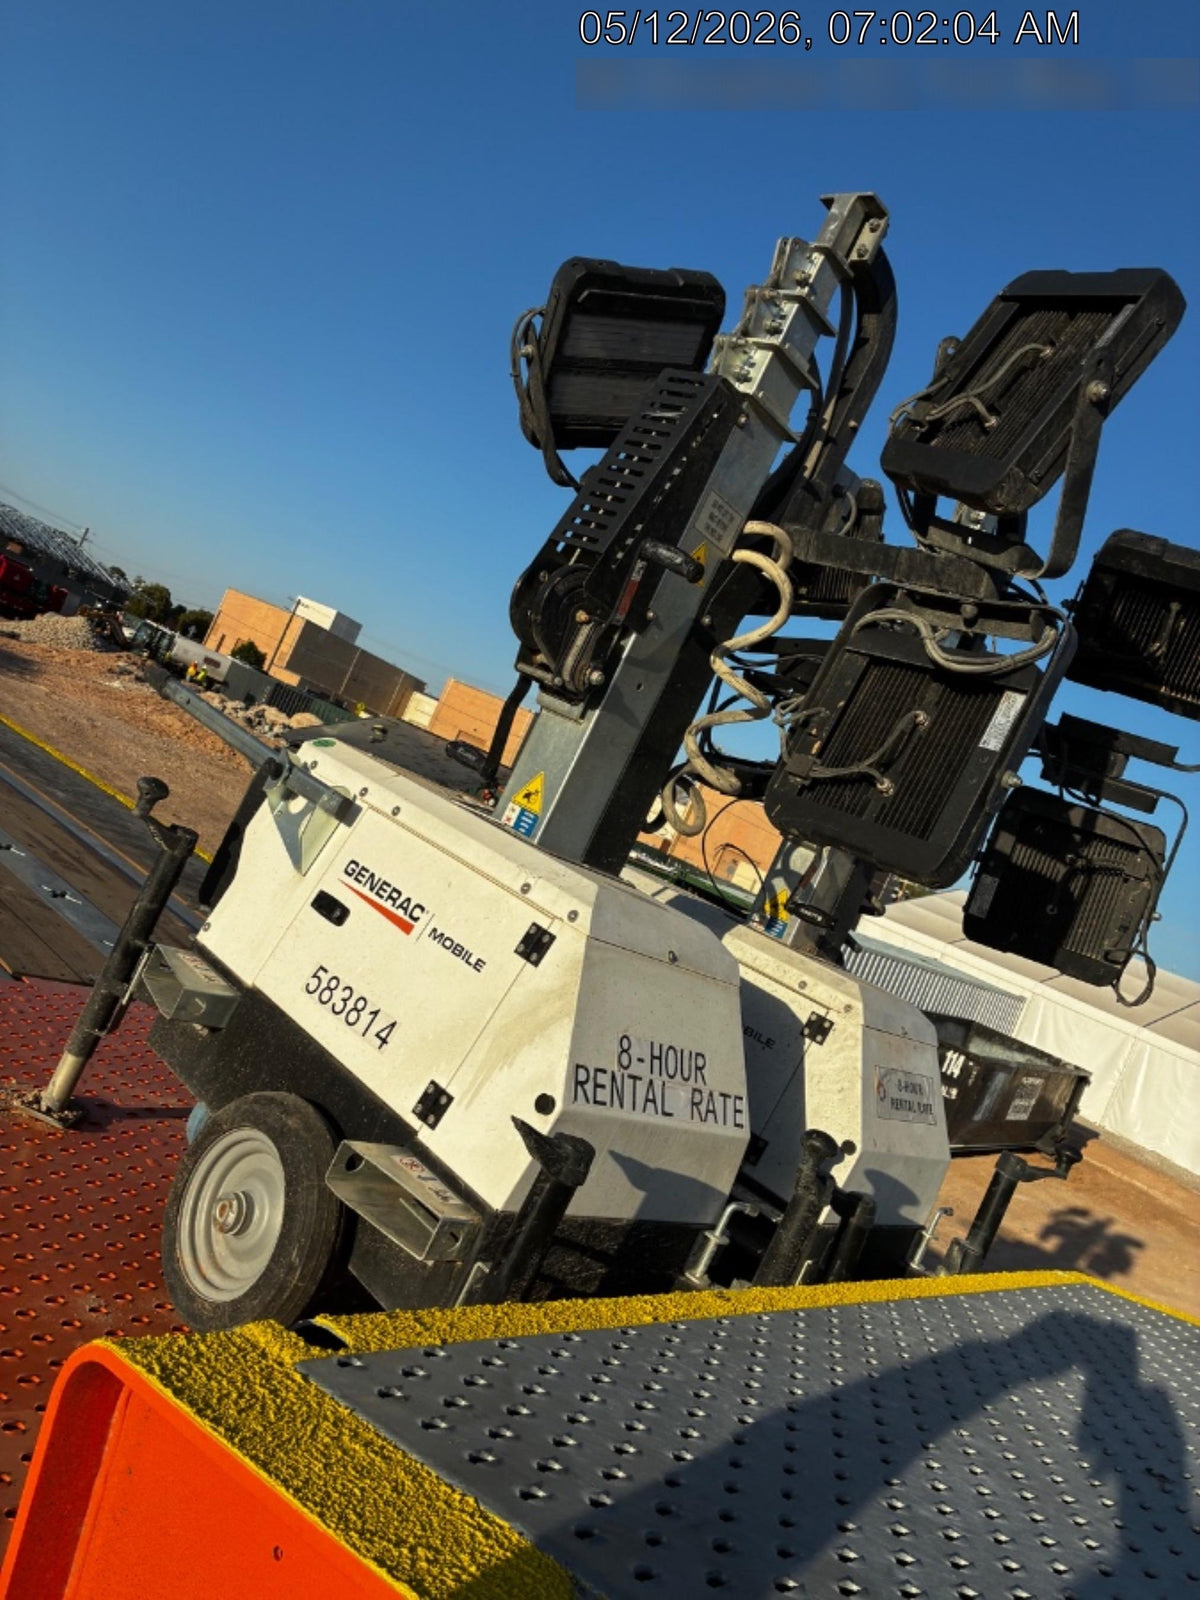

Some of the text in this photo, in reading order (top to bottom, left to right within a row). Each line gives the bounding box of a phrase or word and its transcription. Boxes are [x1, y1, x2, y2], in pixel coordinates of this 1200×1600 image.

[343, 859, 487, 974] GENERAC MOBILE
[304, 964, 398, 1050] 583814
[742, 1026, 776, 1049] BILE
[617, 1034, 708, 1086] 8-HOUR
[573, 1063, 744, 1129] RENTAL RATE
